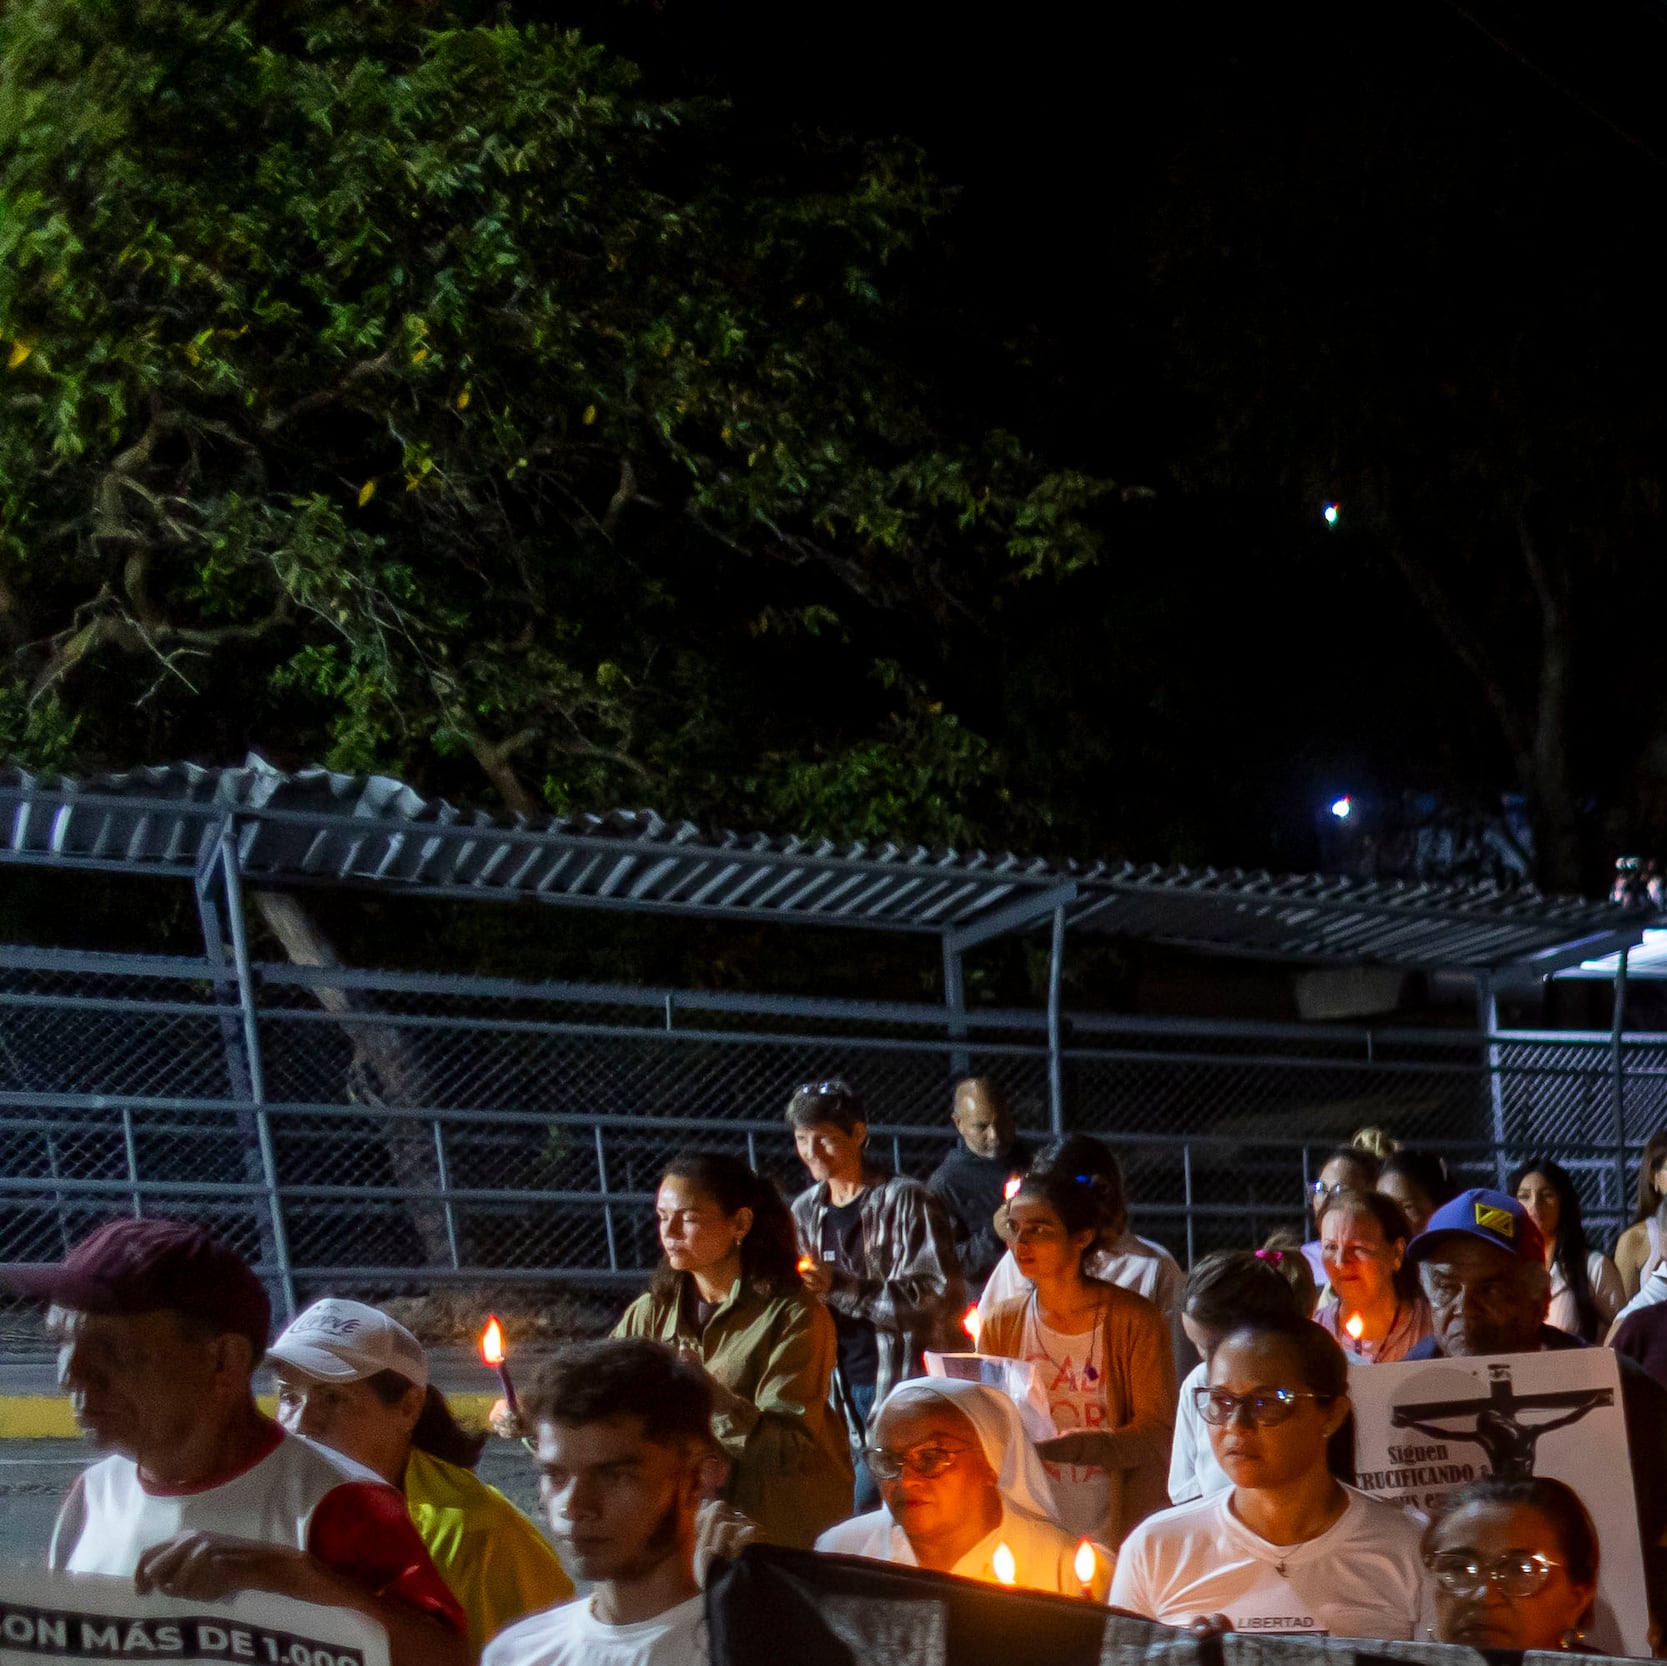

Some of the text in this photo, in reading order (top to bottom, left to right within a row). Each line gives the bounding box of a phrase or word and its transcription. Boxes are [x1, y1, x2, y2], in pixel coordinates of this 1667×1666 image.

[1388, 1445, 1449, 1465] Siguen
[1237, 1617, 1314, 1628] LIBERTAD
[0, 1614, 66, 1648] ON
[82, 1621, 183, 1652] MÁS
[200, 1625, 256, 1657] DE
